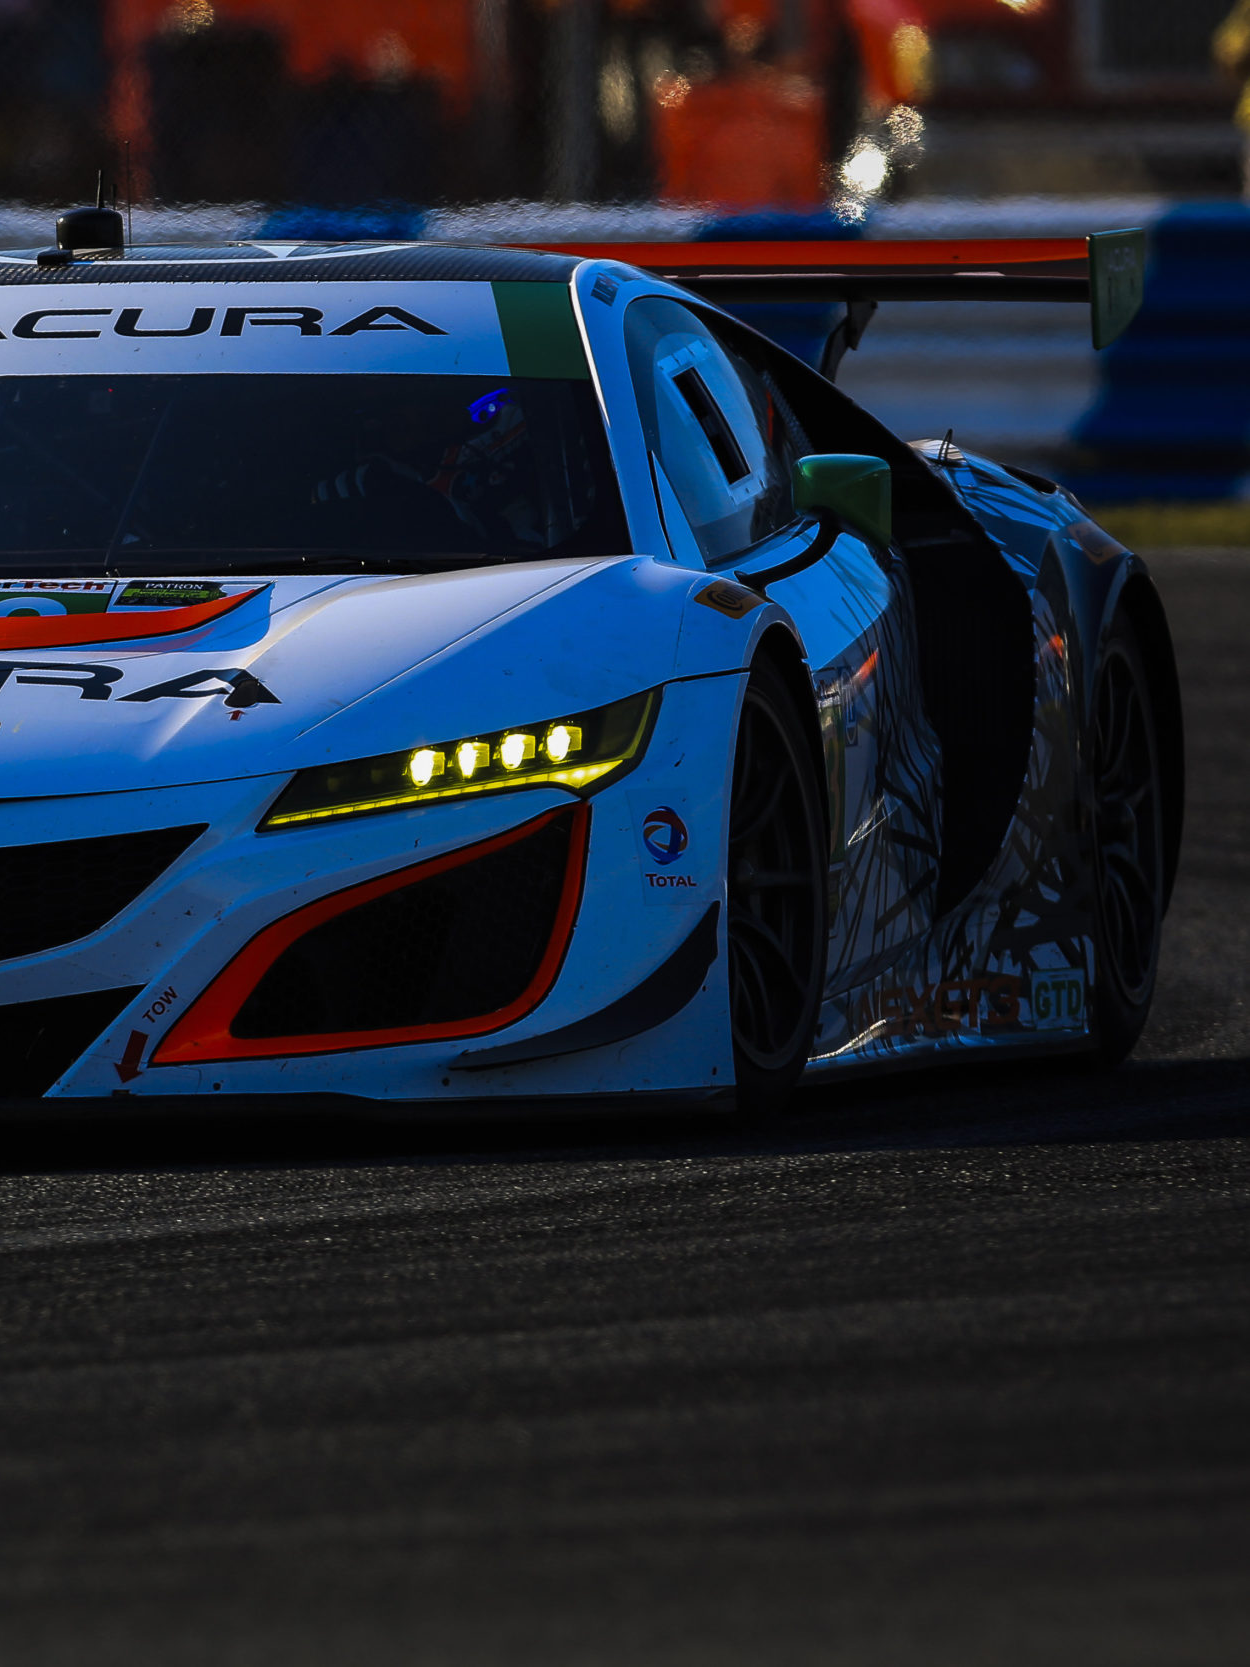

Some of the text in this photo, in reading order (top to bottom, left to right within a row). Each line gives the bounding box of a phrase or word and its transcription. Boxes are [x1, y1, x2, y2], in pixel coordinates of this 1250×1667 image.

[145, 582, 204, 590] PATRON
[142, 985, 178, 1024] TOW
[1034, 979, 1082, 1018] GTD
